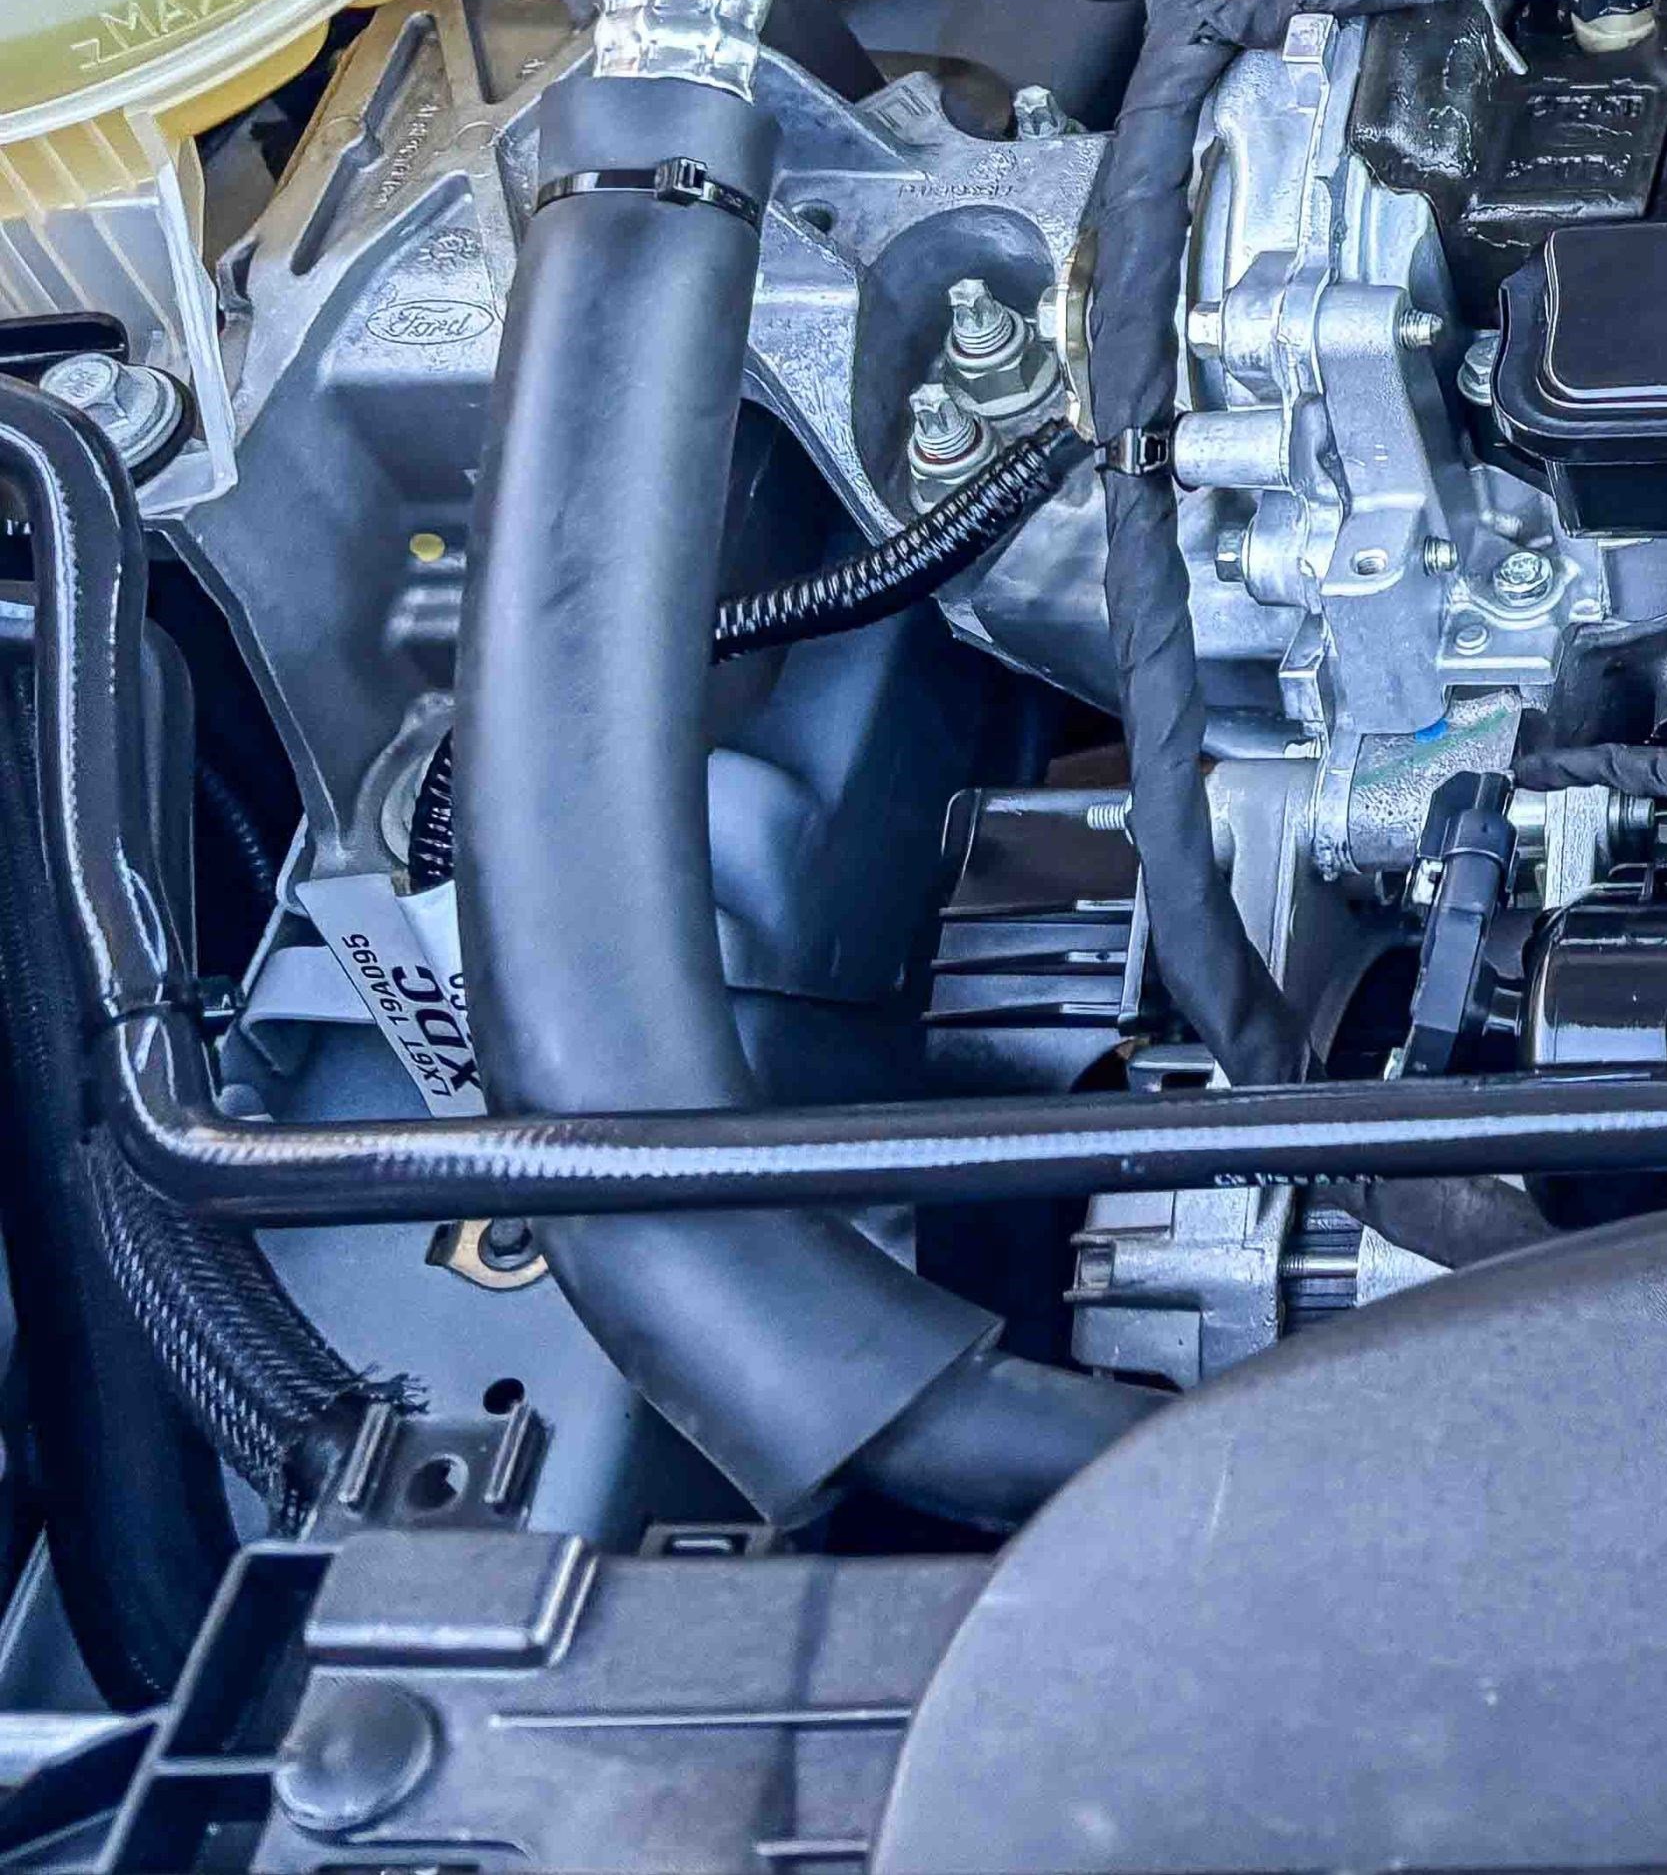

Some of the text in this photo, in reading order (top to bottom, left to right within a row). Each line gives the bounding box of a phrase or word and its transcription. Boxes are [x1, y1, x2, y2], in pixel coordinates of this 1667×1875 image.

[388, 307, 470, 340] Ford
[342, 932, 453, 1098] LX6T 19A095
[394, 965, 483, 1091] XDC
